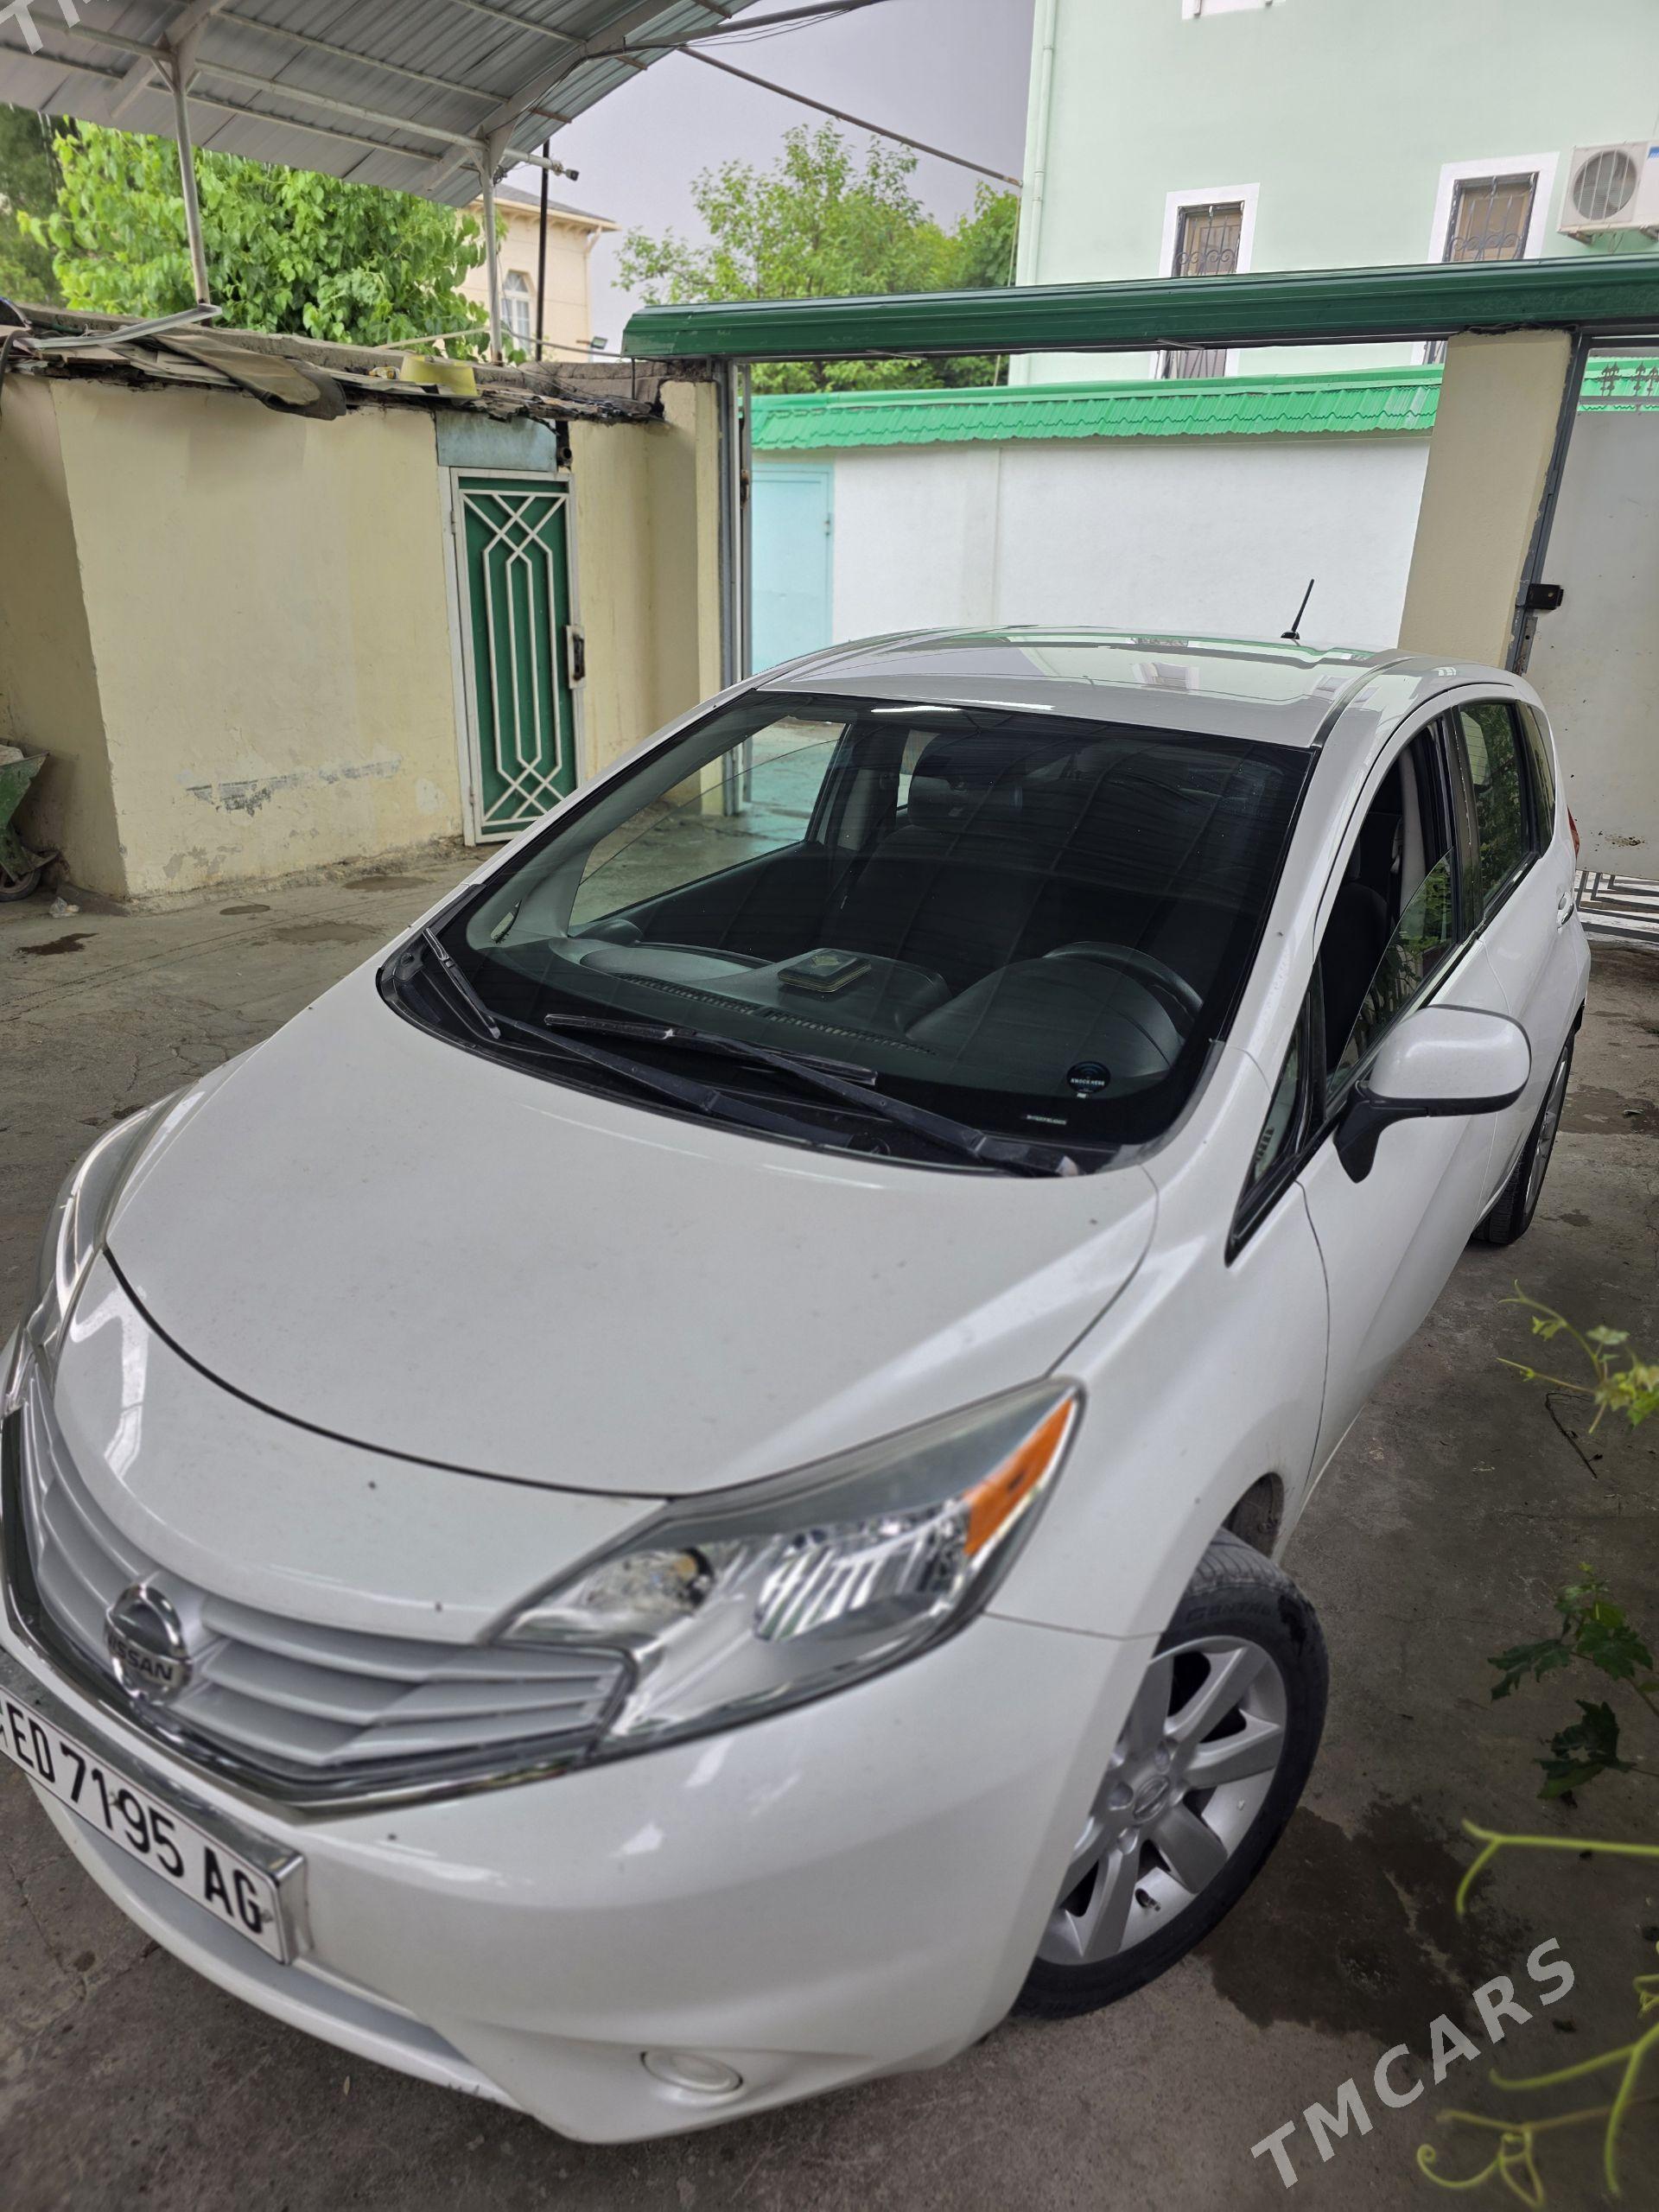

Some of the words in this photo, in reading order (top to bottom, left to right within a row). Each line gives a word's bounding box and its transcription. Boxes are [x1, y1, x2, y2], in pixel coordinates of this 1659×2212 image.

[6, 1700, 55, 1783] ED
[60, 1741, 185, 1878] 7195
[204, 1846, 264, 1935] AG
